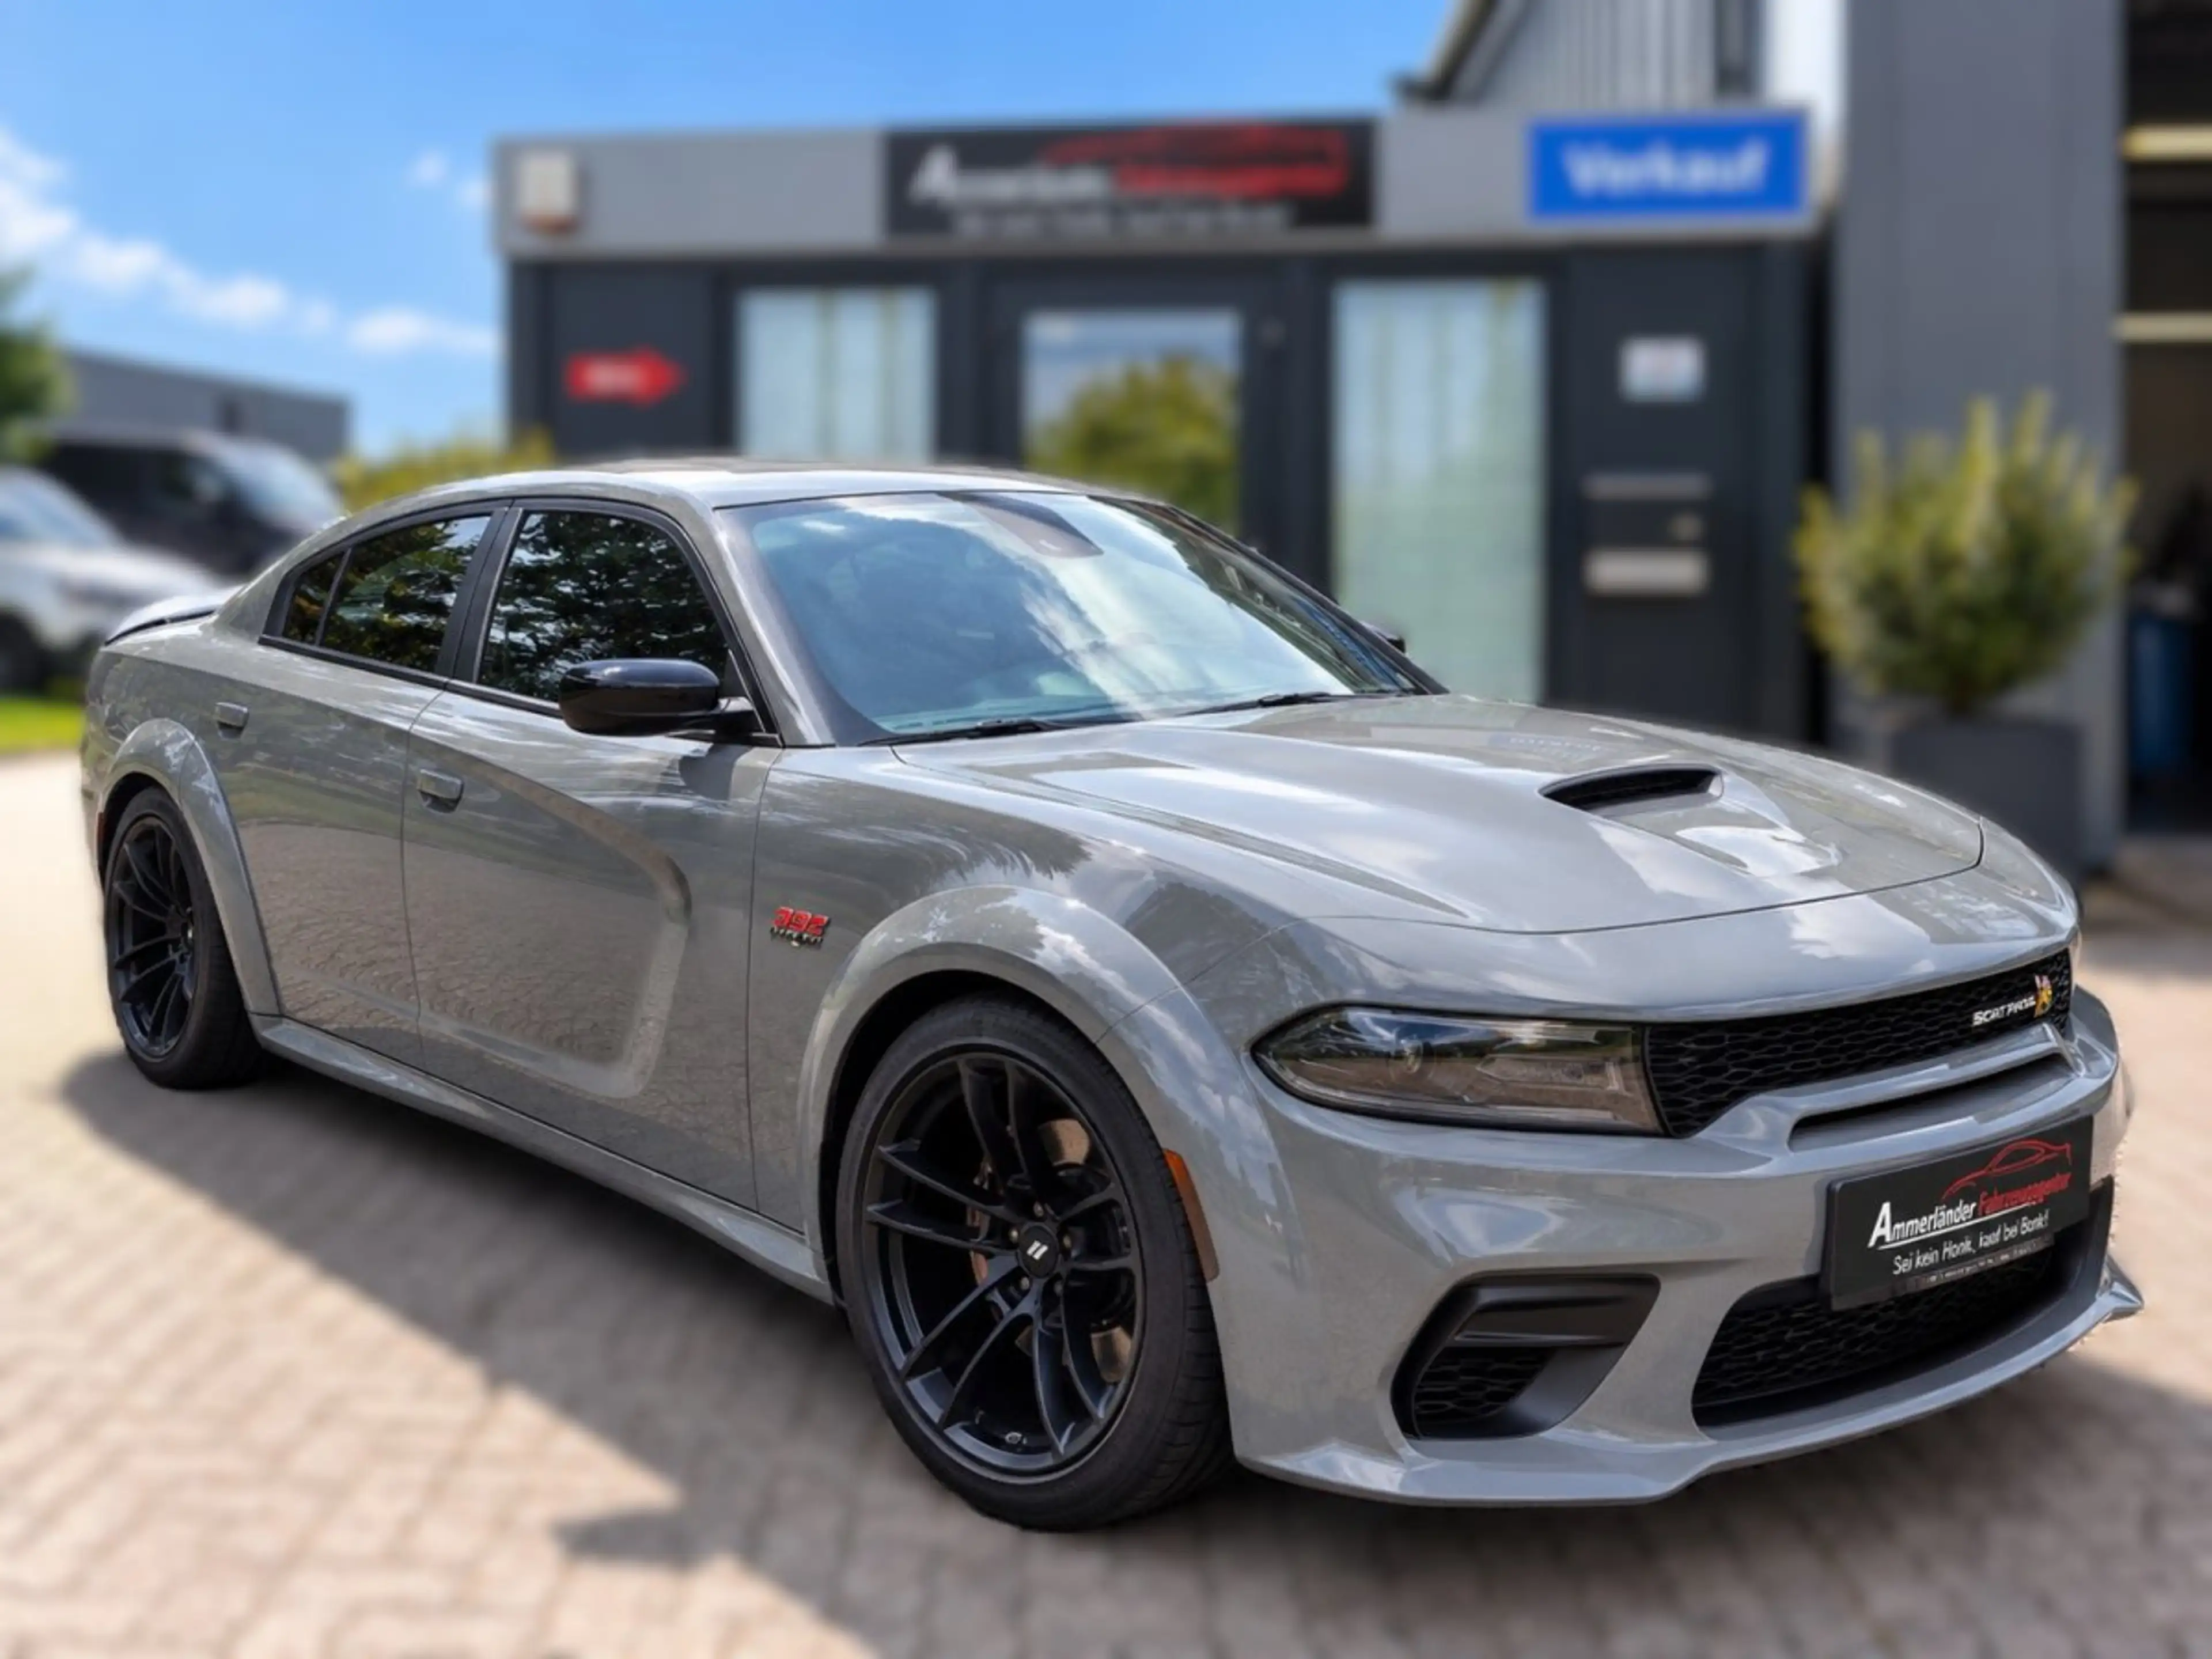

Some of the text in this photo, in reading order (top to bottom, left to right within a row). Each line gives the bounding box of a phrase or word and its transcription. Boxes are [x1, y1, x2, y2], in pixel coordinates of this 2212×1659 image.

[1562, 135, 1767, 199] Verkauf
[1867, 1198, 1976, 1249] Ammerländer
[1893, 1251, 1913, 1275] Sei
[1915, 1247, 1939, 1268] kein
[1942, 1235, 1977, 1262] Honk,
[2003, 1219, 2020, 1241] bei
